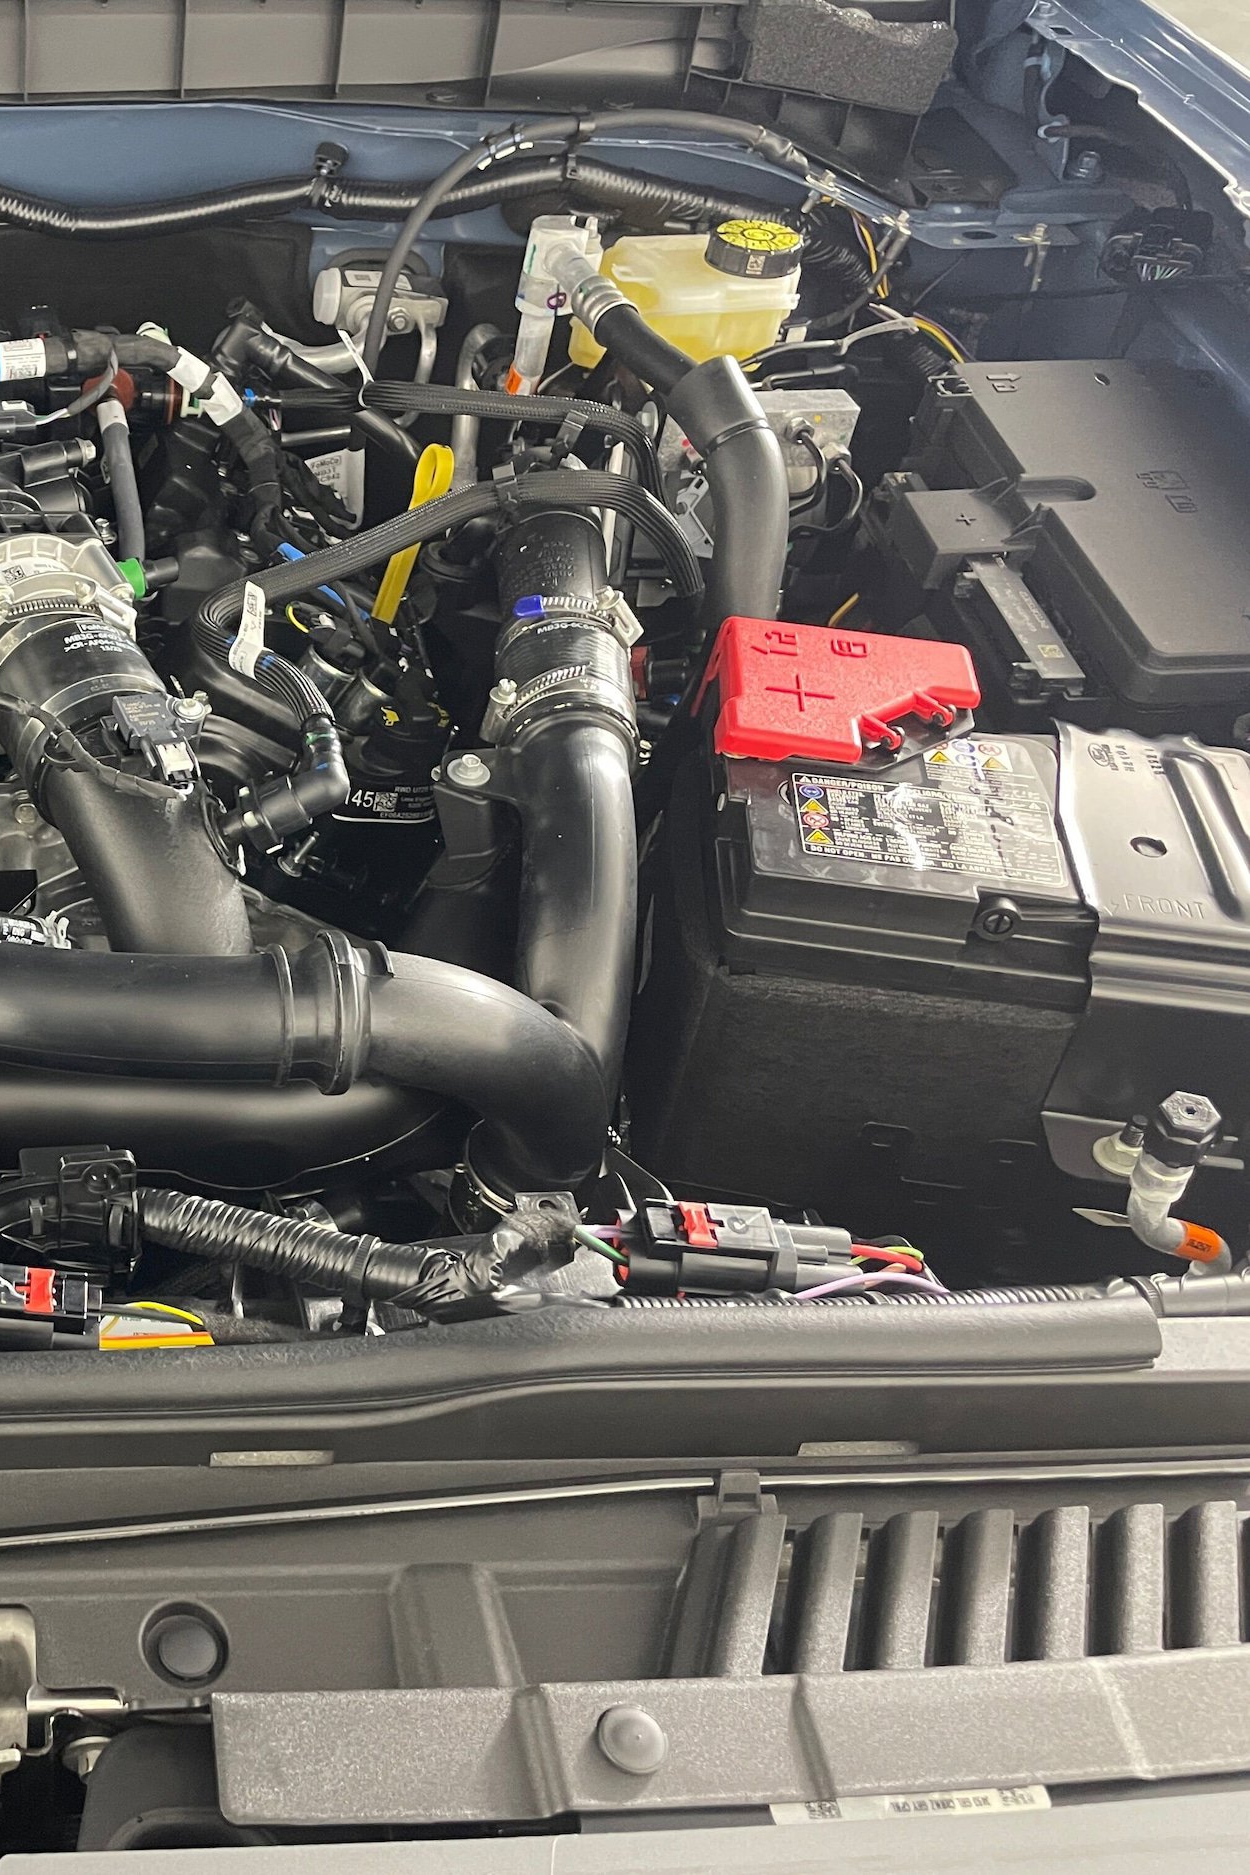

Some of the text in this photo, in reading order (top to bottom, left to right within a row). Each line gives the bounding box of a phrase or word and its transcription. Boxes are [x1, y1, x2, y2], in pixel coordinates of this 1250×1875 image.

[311, 456, 340, 469] FoMoCo
[811, 776, 885, 792] DANGER/POISON
[811, 845, 822, 853] DO
[824, 847, 841, 855] NOT
[1122, 893, 1206, 920] FRONT
